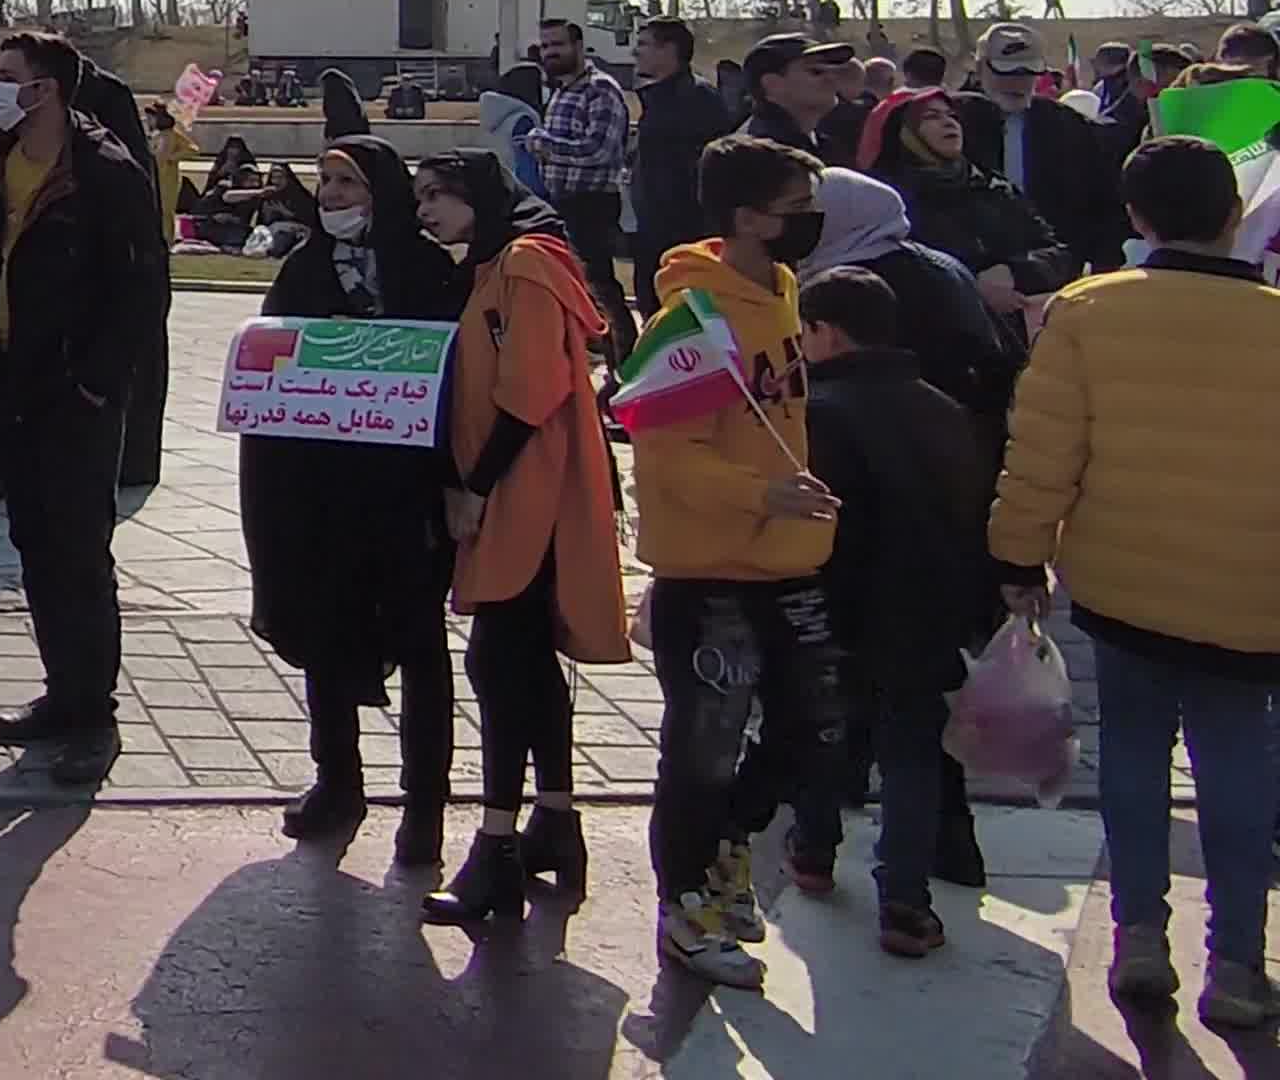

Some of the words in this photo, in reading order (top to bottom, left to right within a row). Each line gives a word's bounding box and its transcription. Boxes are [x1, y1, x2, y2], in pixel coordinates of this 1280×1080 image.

[228, 374, 273, 393] است
[278, 375, 337, 397] ملت
[344, 379, 378, 404] یک
[383, 378, 429, 405] قیام
[224, 402, 286, 430] قدرتها
[291, 410, 331, 426] همه
[336, 408, 395, 434] مقابل
[400, 417, 429, 439] در
